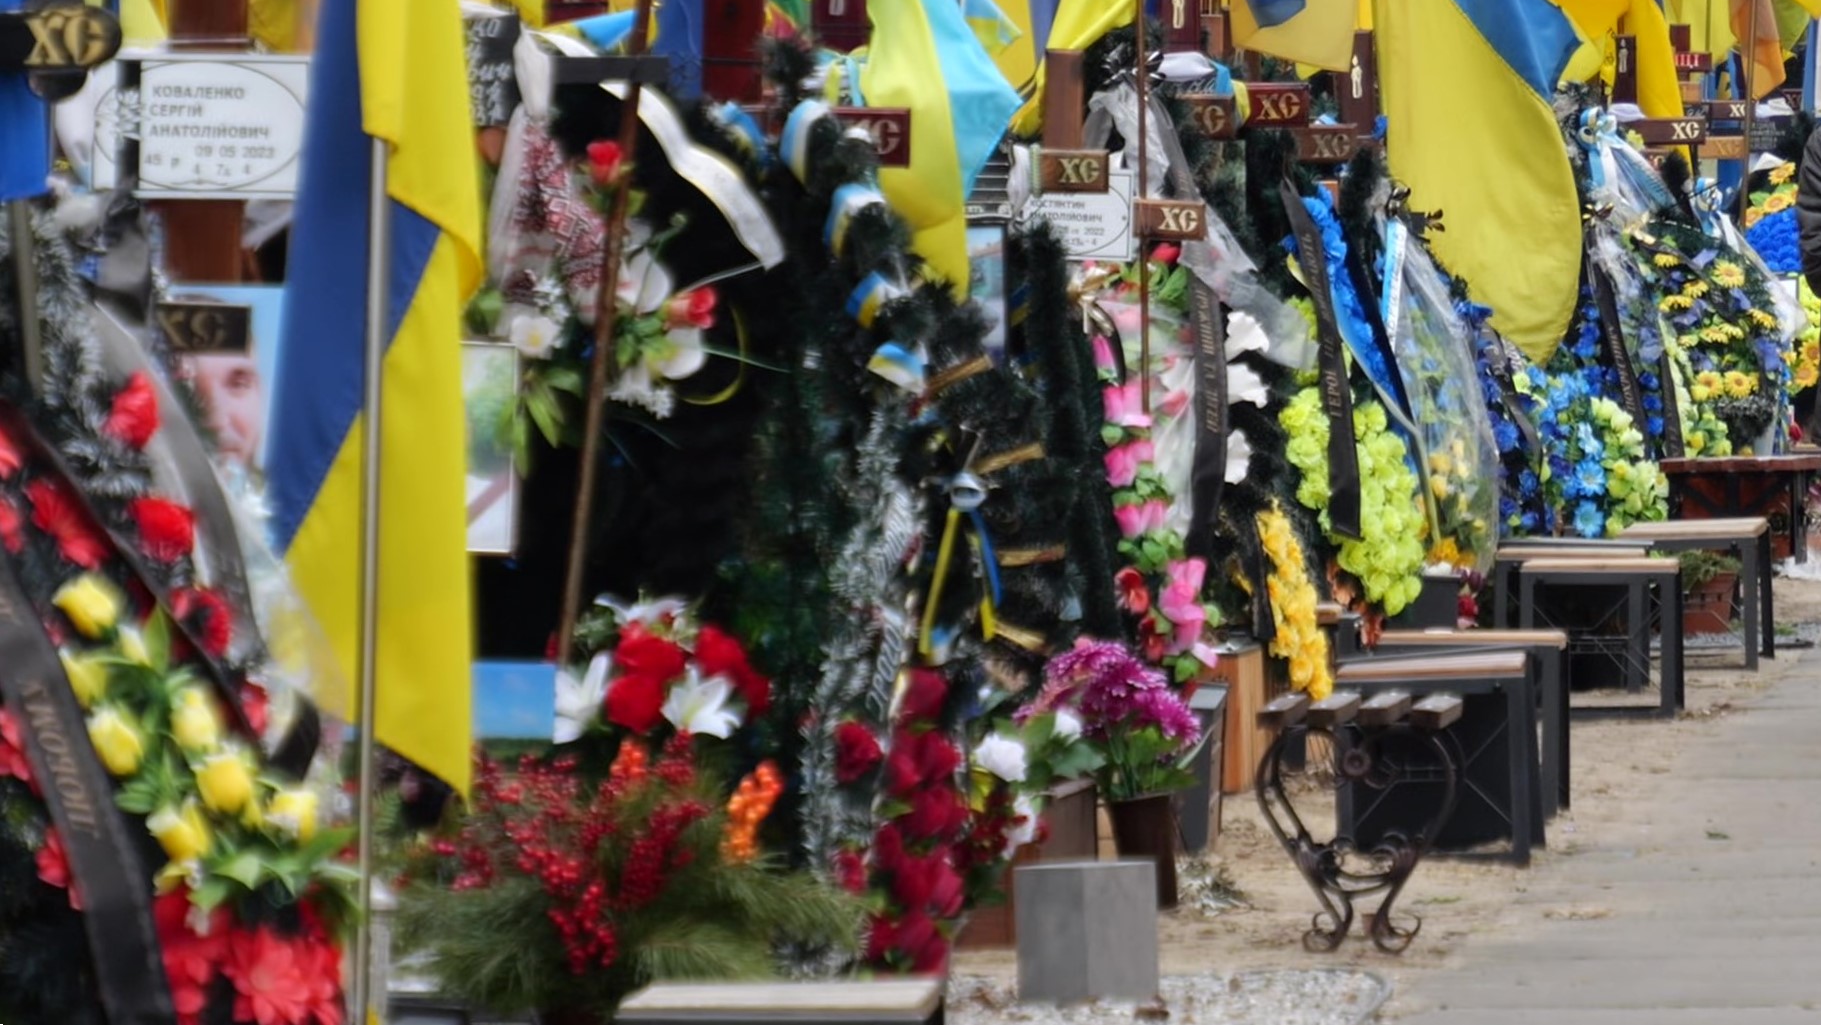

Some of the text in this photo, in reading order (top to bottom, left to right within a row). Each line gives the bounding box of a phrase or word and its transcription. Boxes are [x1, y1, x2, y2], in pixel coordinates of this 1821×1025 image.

[152, 85, 246, 100] КОВАЛЕНКО
[149, 103, 203, 117] СЕРГІЙ
[149, 125, 269, 139] АНАТОЛІЙОВИЧ
